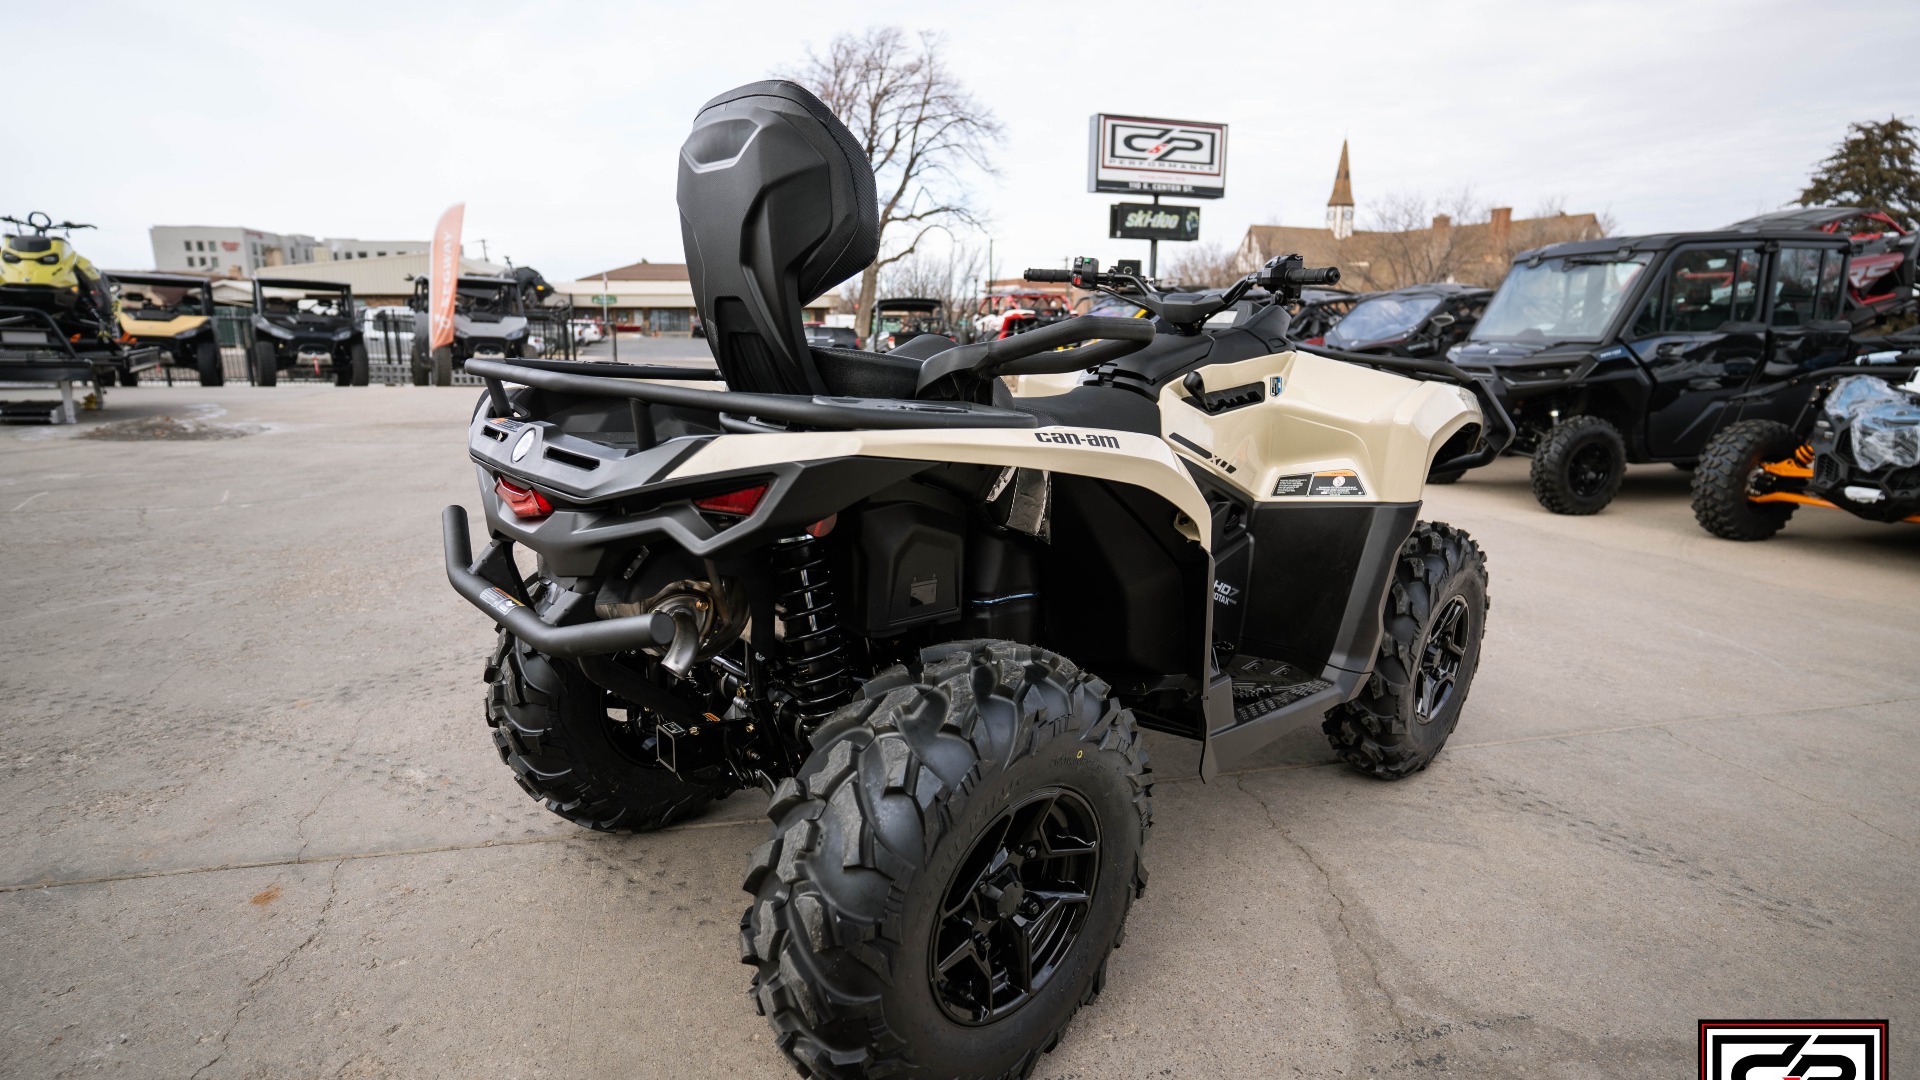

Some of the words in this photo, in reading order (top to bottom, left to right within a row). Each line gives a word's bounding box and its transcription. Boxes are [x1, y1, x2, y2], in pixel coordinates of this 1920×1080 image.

[1108, 159, 1215, 172] PERFORMANCE
[1152, 183, 1182, 192] CENTER
[441, 230, 453, 308] SEGWAY
[1213, 592, 1230, 606] OTAX
